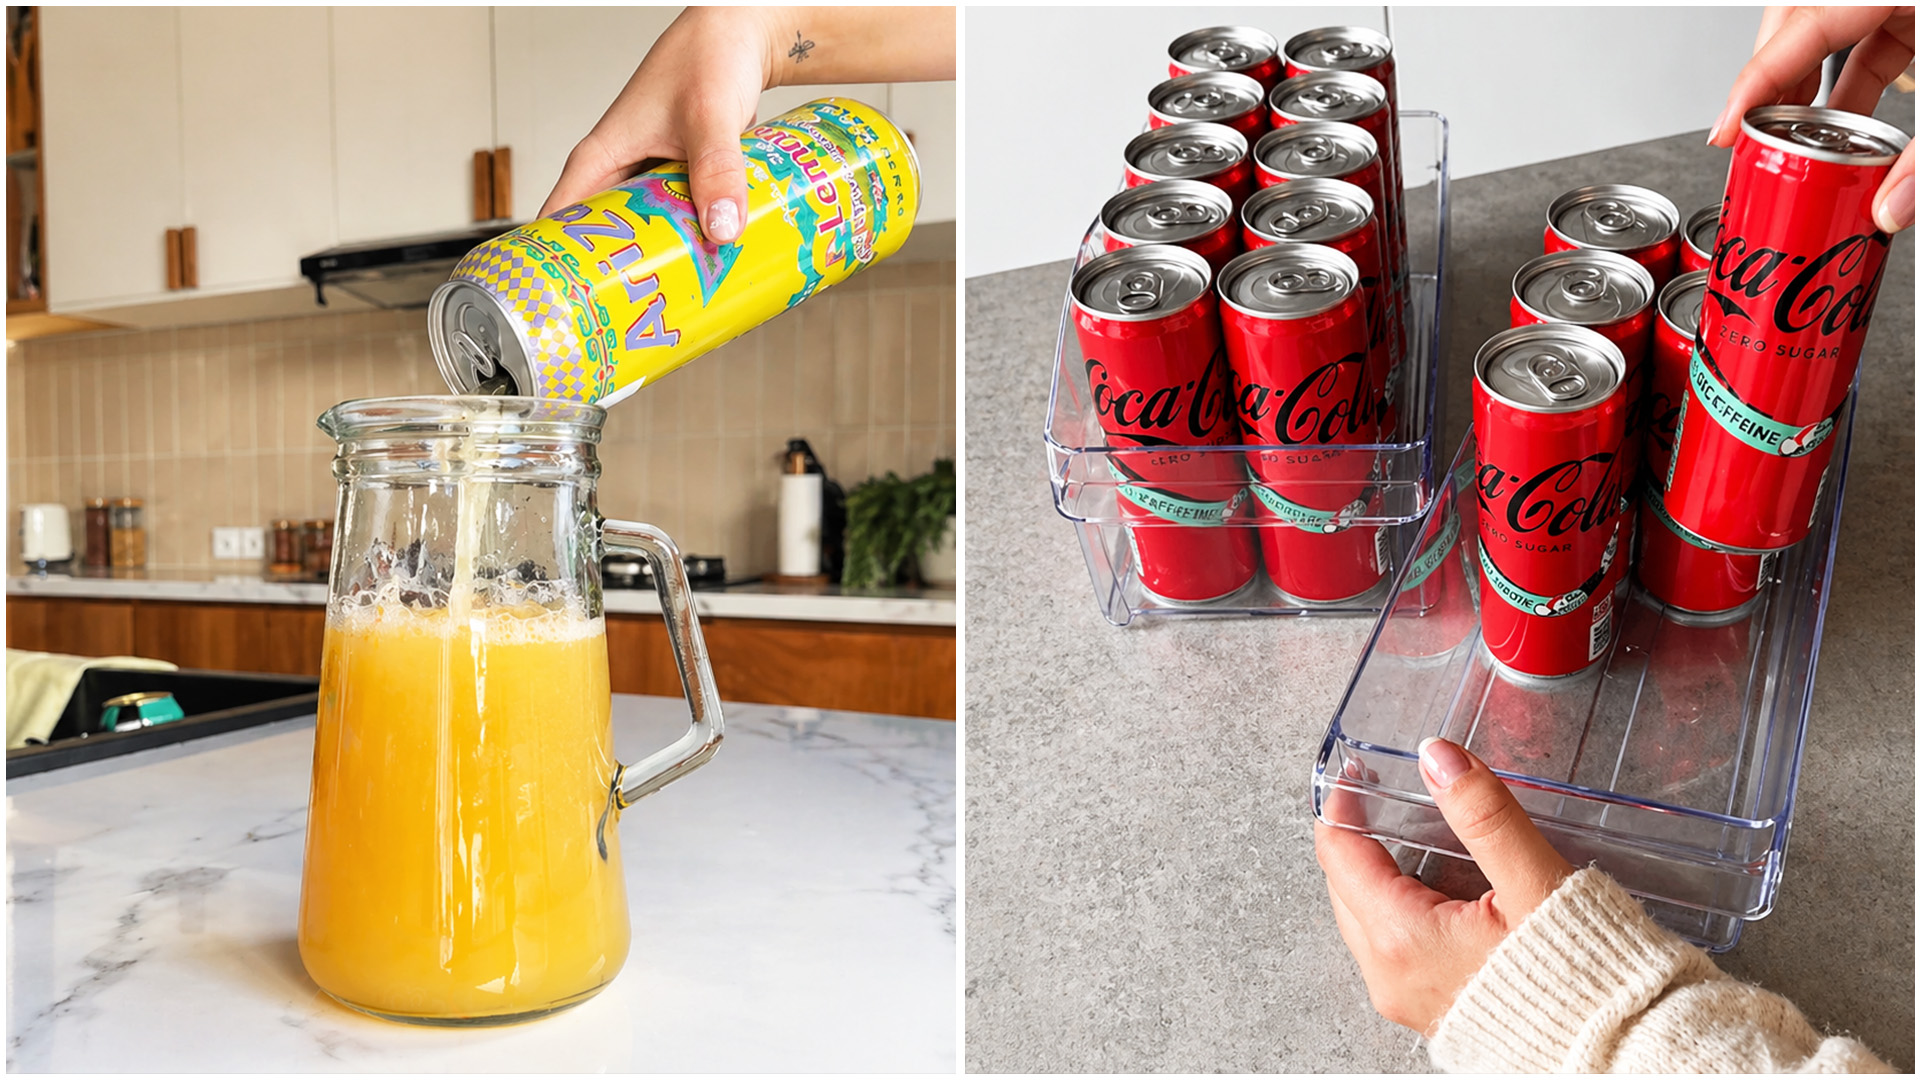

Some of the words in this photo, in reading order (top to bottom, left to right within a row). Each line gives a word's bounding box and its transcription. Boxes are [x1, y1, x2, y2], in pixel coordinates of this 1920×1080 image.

[1719, 325, 1767, 352] ZERO
[1776, 344, 1840, 360] SUGAR
[1515, 540, 1573, 553] SUGAR
